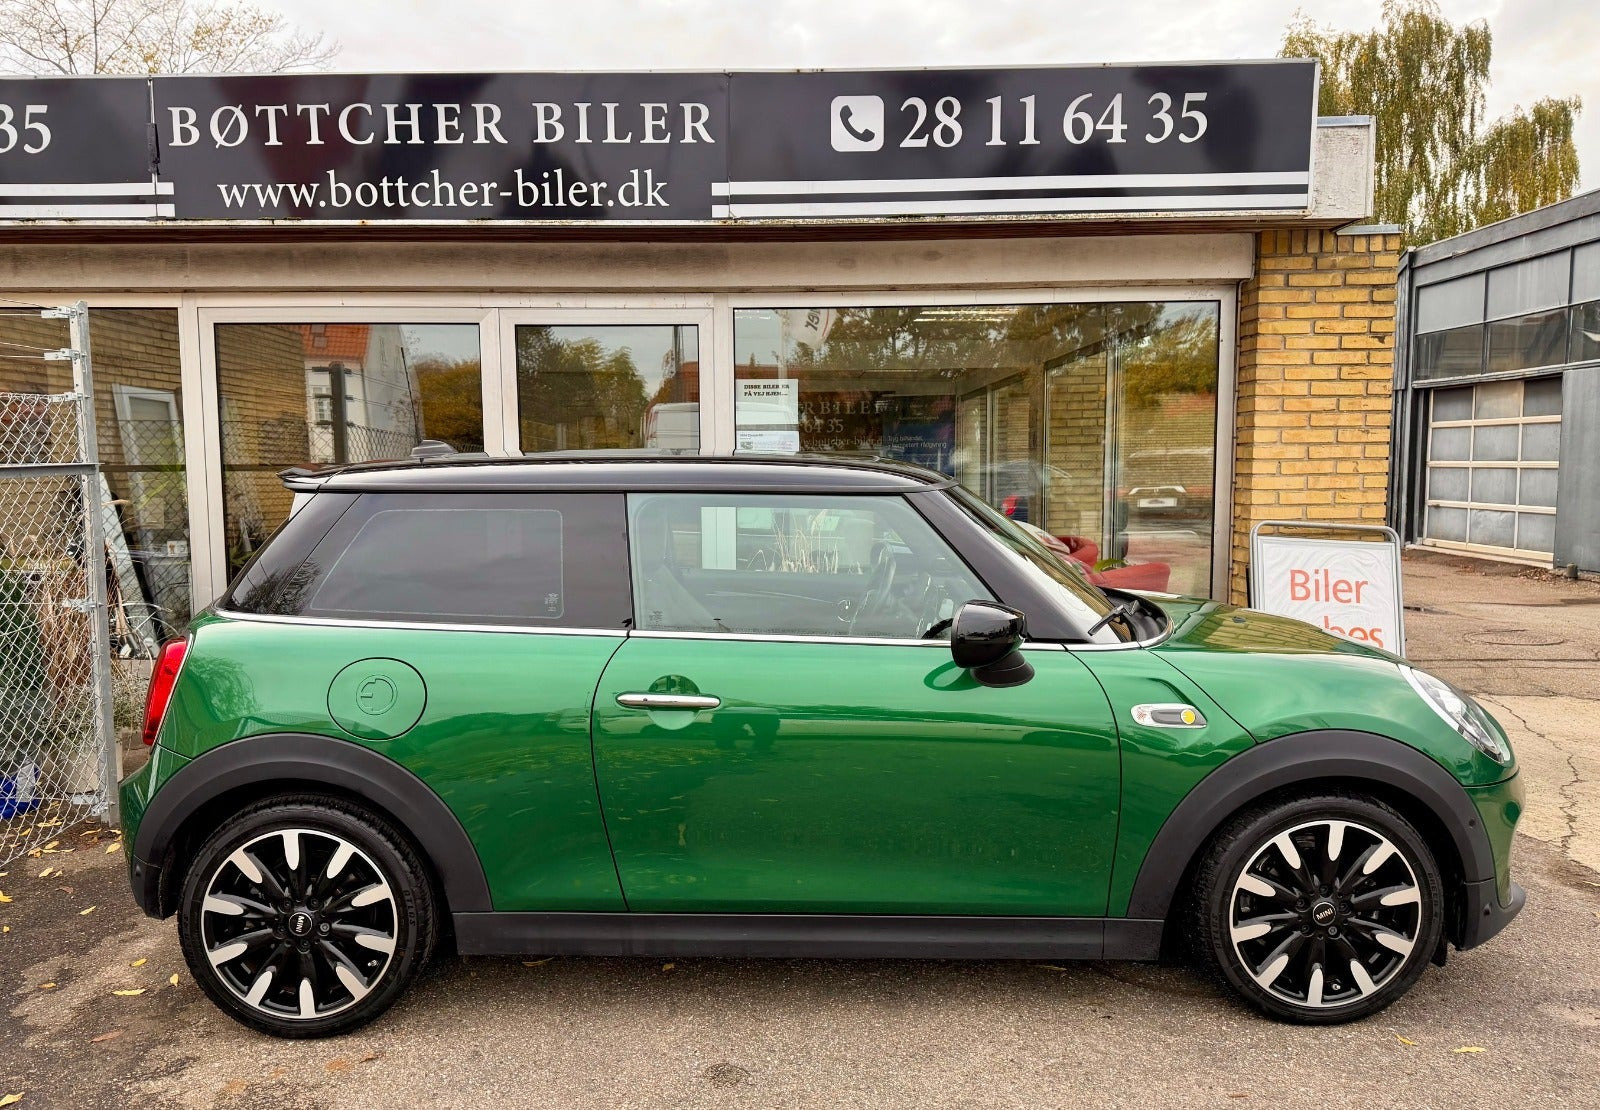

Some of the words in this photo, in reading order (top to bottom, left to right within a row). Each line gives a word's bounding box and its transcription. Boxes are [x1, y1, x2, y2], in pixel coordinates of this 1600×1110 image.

[0, 104, 51, 154] 35
[168, 103, 508, 149] BØTTCHER
[532, 102, 715, 143] BILER
[900, 97, 962, 148] 28
[986, 95, 1040, 146] 11
[1063, 93, 1127, 144] 64
[1146, 93, 1207, 144] 35
[217, 168, 669, 208] www.bottcher-biler.dk
[1290, 569, 1368, 604] Biler
[295, 915, 305, 933] MINI
[1316, 908, 1333, 920] MINI
